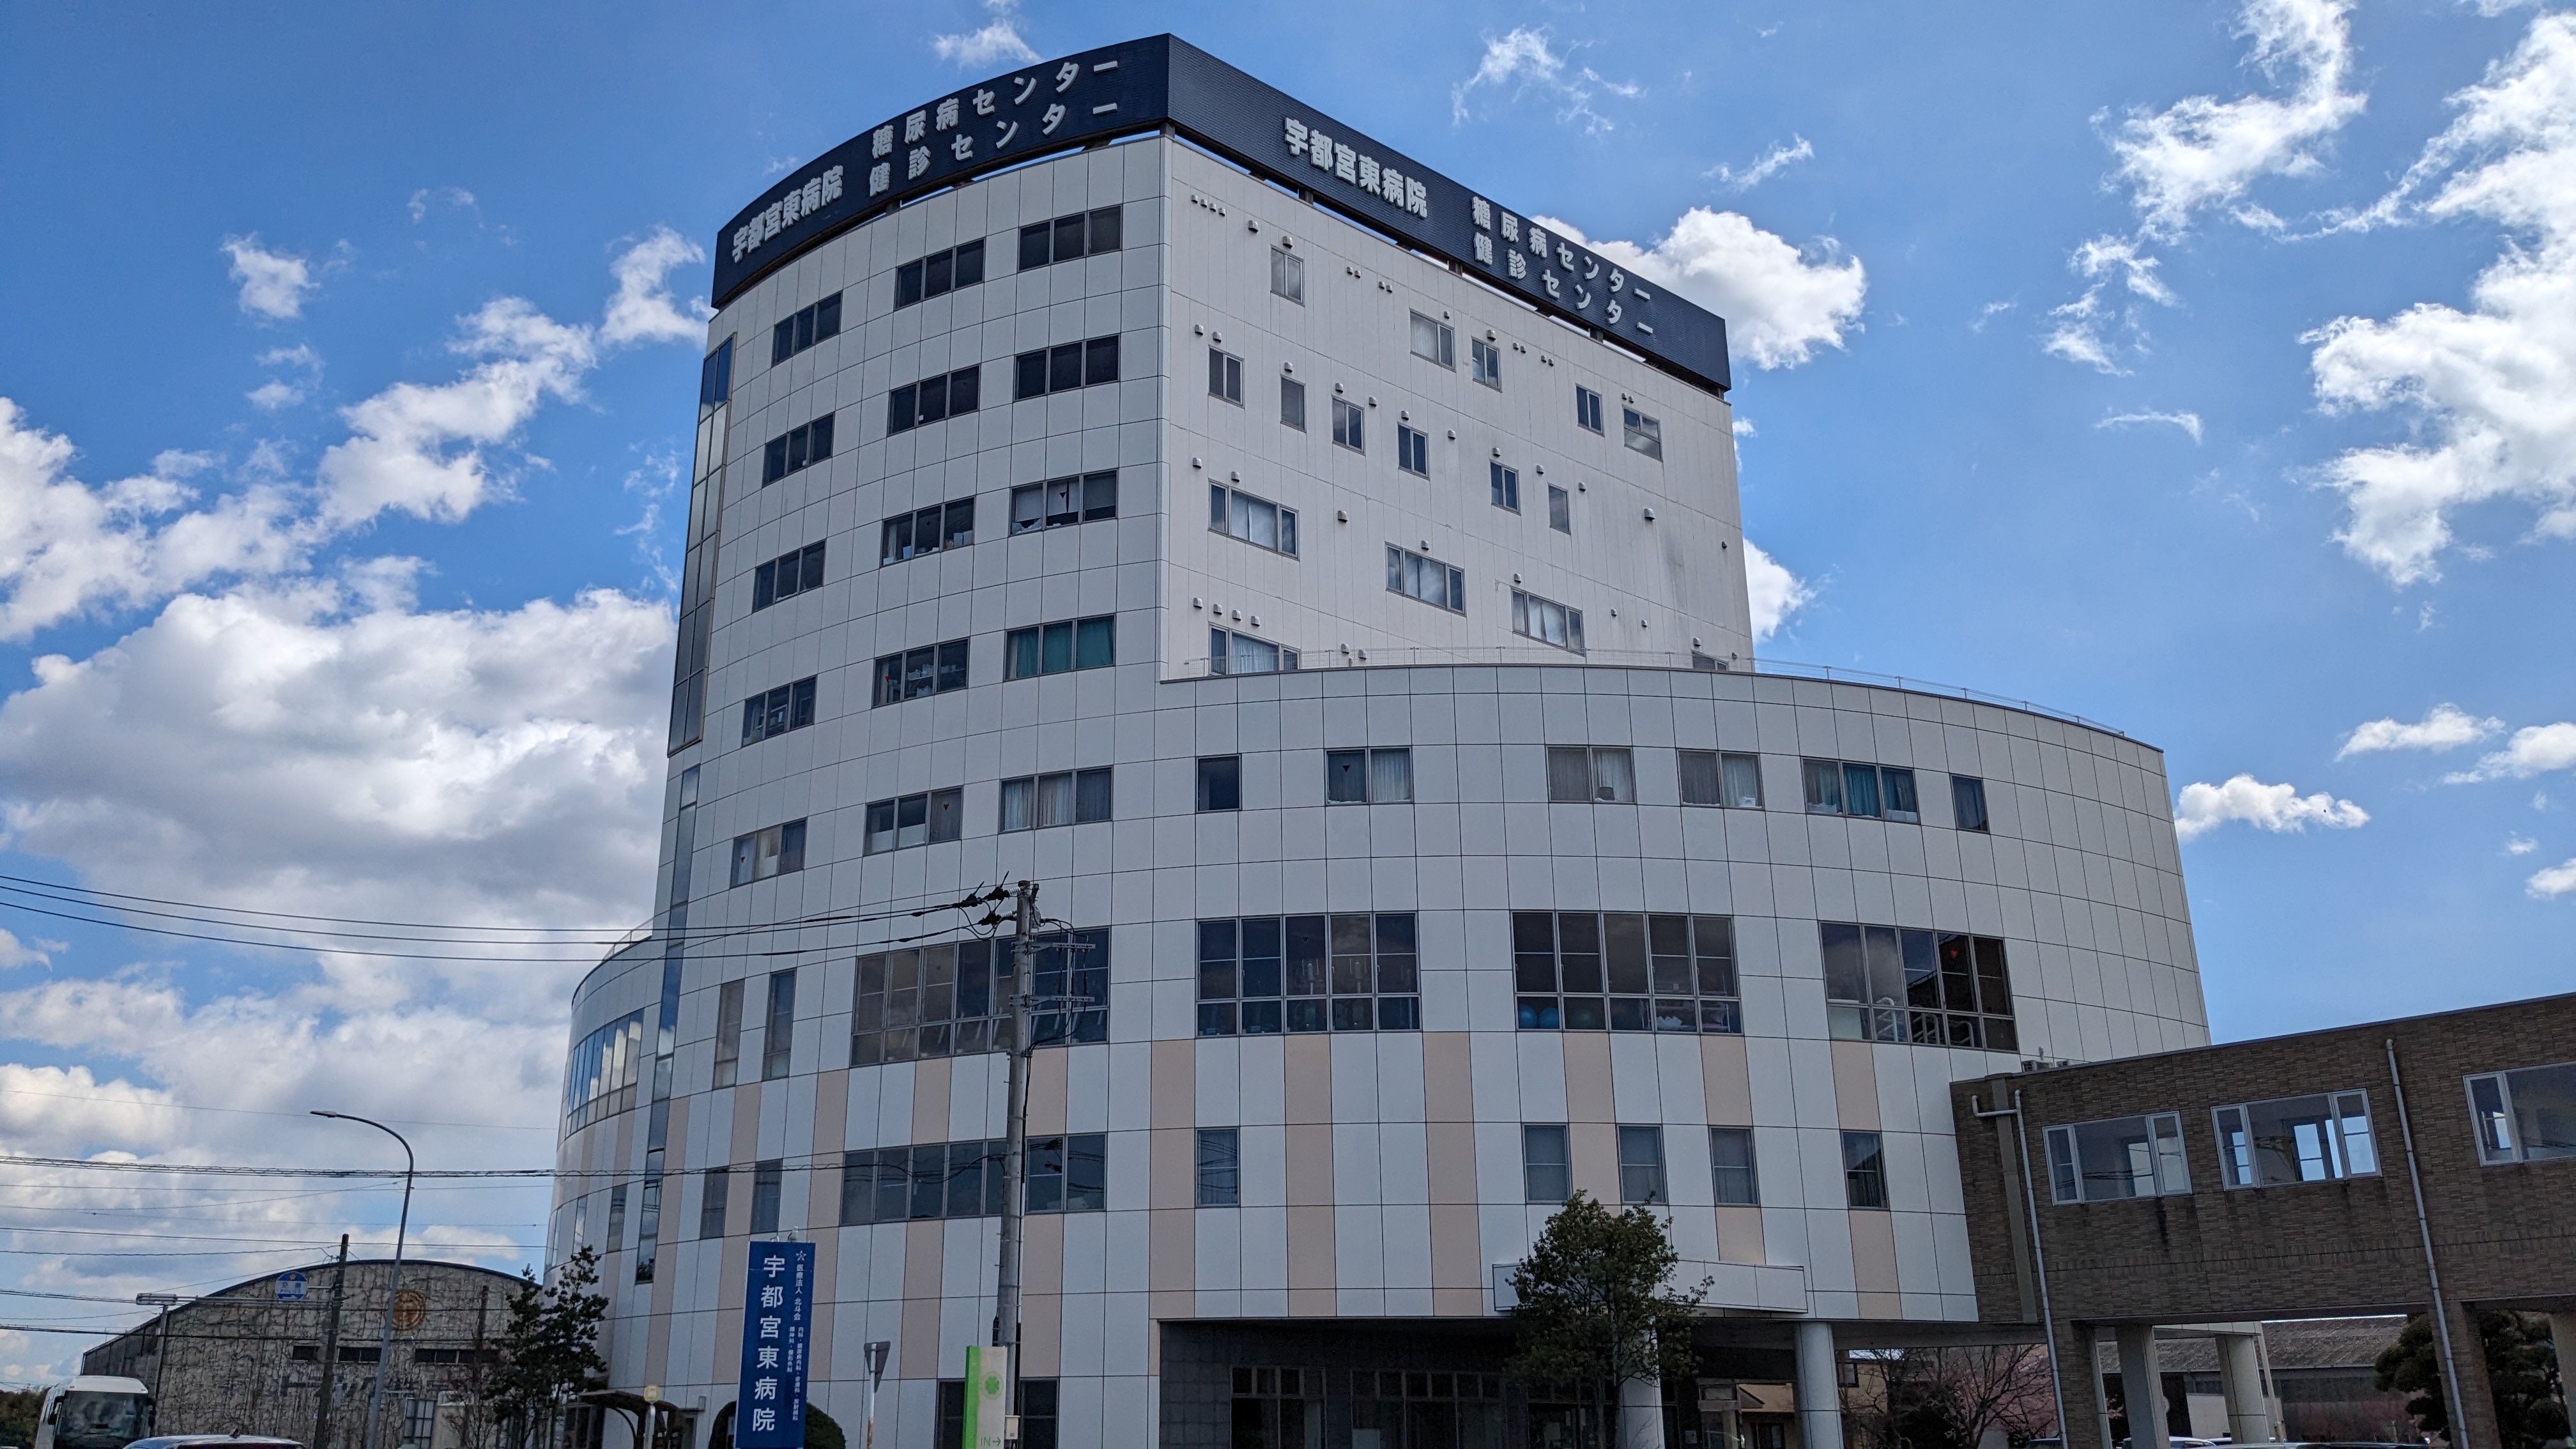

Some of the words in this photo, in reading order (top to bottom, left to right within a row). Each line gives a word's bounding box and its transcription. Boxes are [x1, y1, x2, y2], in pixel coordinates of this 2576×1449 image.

[870, 102, 1118, 197] 健診センター
[871, 60, 1119, 160] 糖尿病センター
[732, 165, 843, 263] 宇都宮東病院
[1284, 118, 1428, 218] 宇都宮東病院
[1471, 195, 1651, 300] 糖尿病センター
[1474, 231, 1653, 335] 健診センター
[752, 1255, 785, 1432] 宇都宮東病院
[981, 1437, 990, 1447] IN
